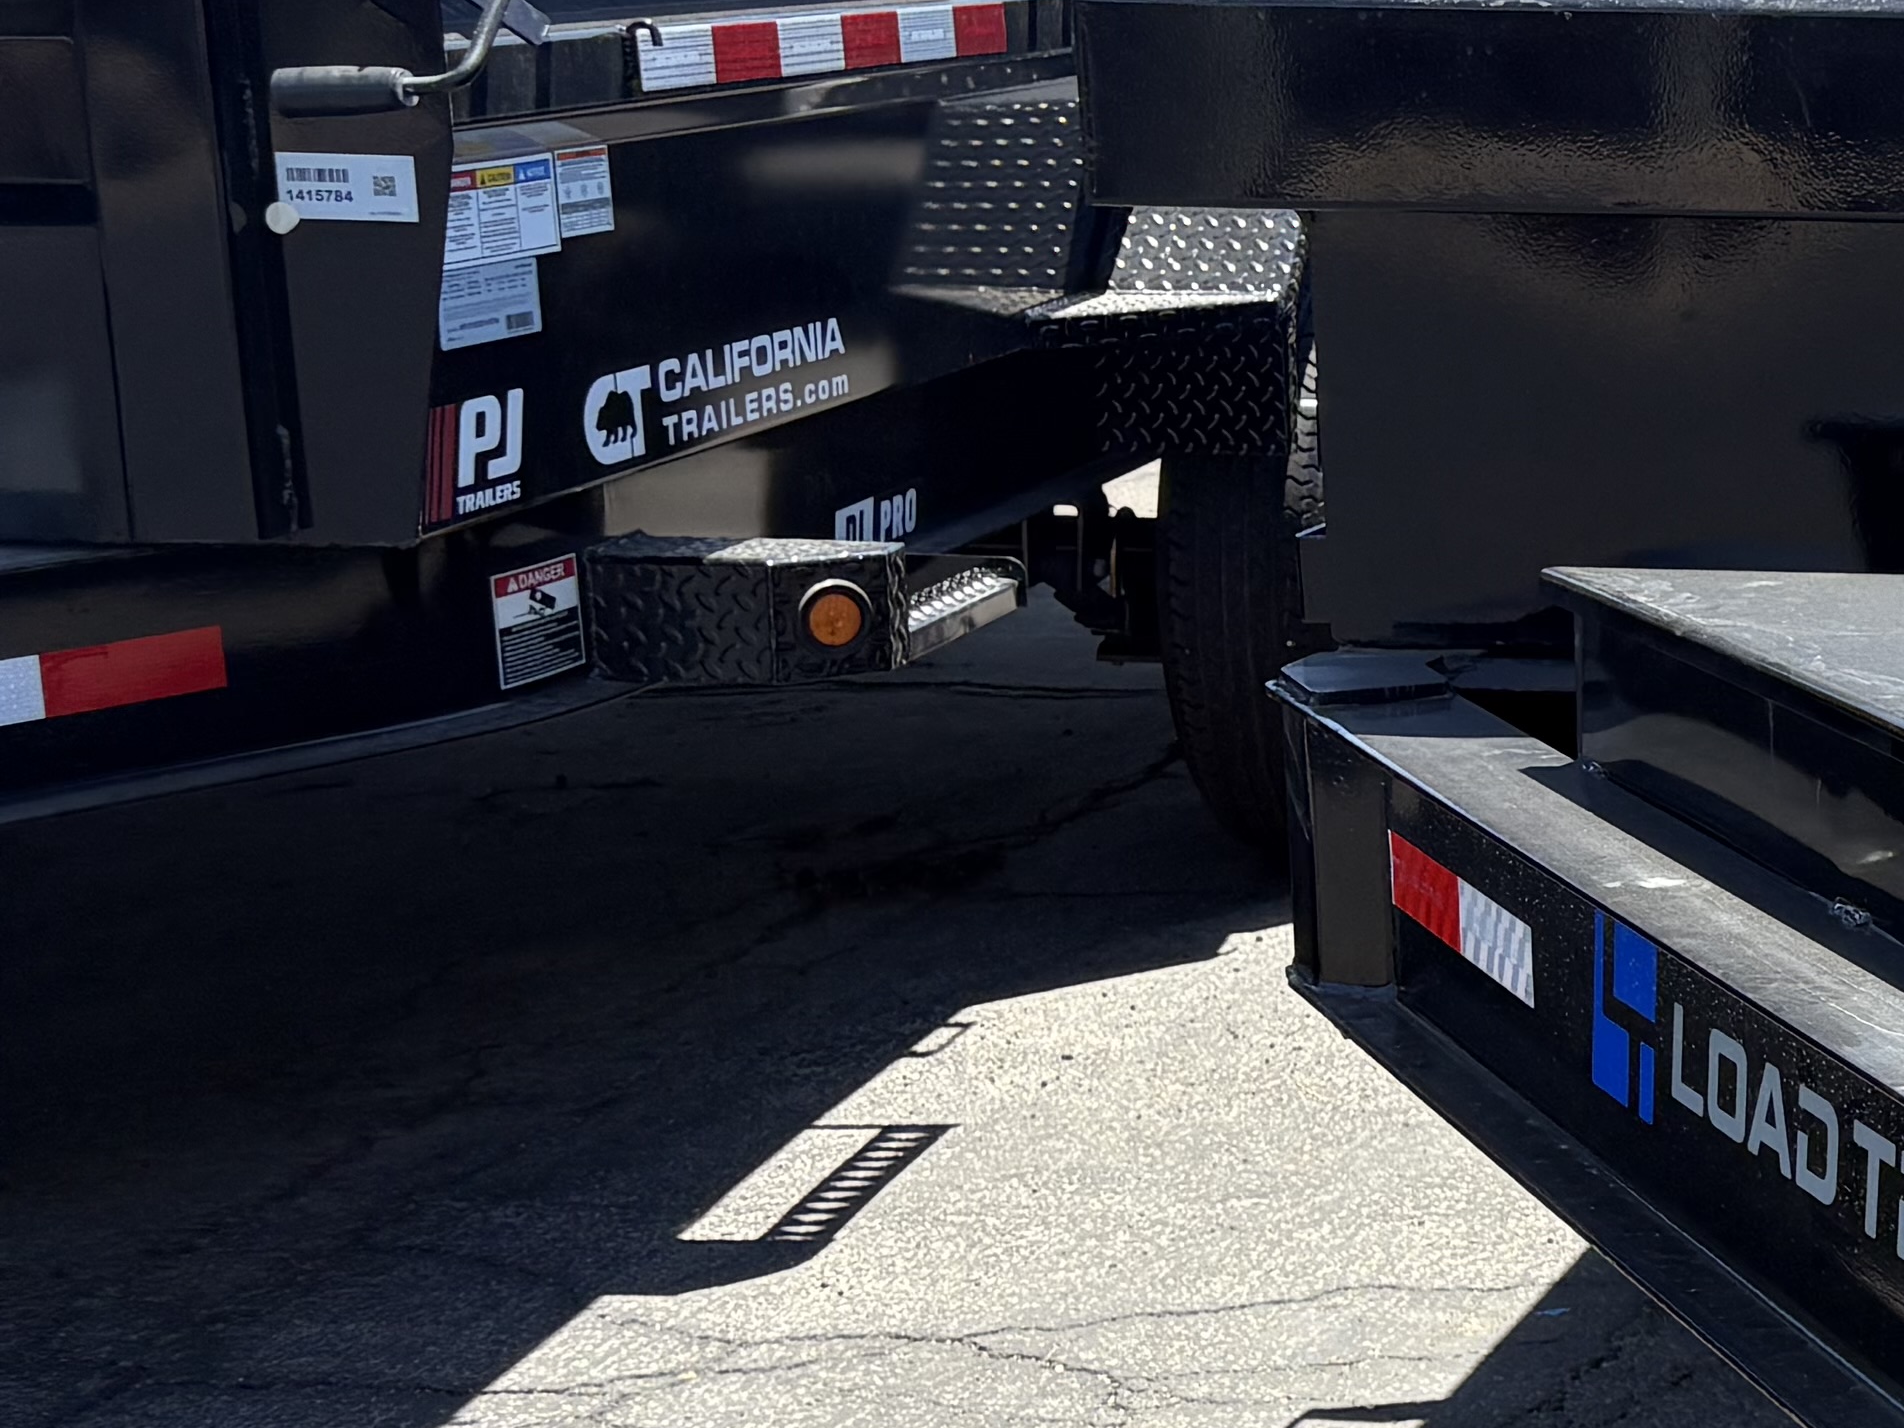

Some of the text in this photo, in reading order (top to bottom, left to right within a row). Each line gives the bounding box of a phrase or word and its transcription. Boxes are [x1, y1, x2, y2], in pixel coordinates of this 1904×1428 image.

[286, 189, 354, 203] 1415784
[657, 317, 846, 404] CALIFORNIA
[457, 387, 524, 488] PJ
[661, 373, 850, 446] TRAILERS.com
[456, 480, 522, 515] TRAILERS
[880, 488, 917, 543] PRO
[518, 562, 565, 589] DANGER
[1672, 1002, 1840, 1205] LOAD
